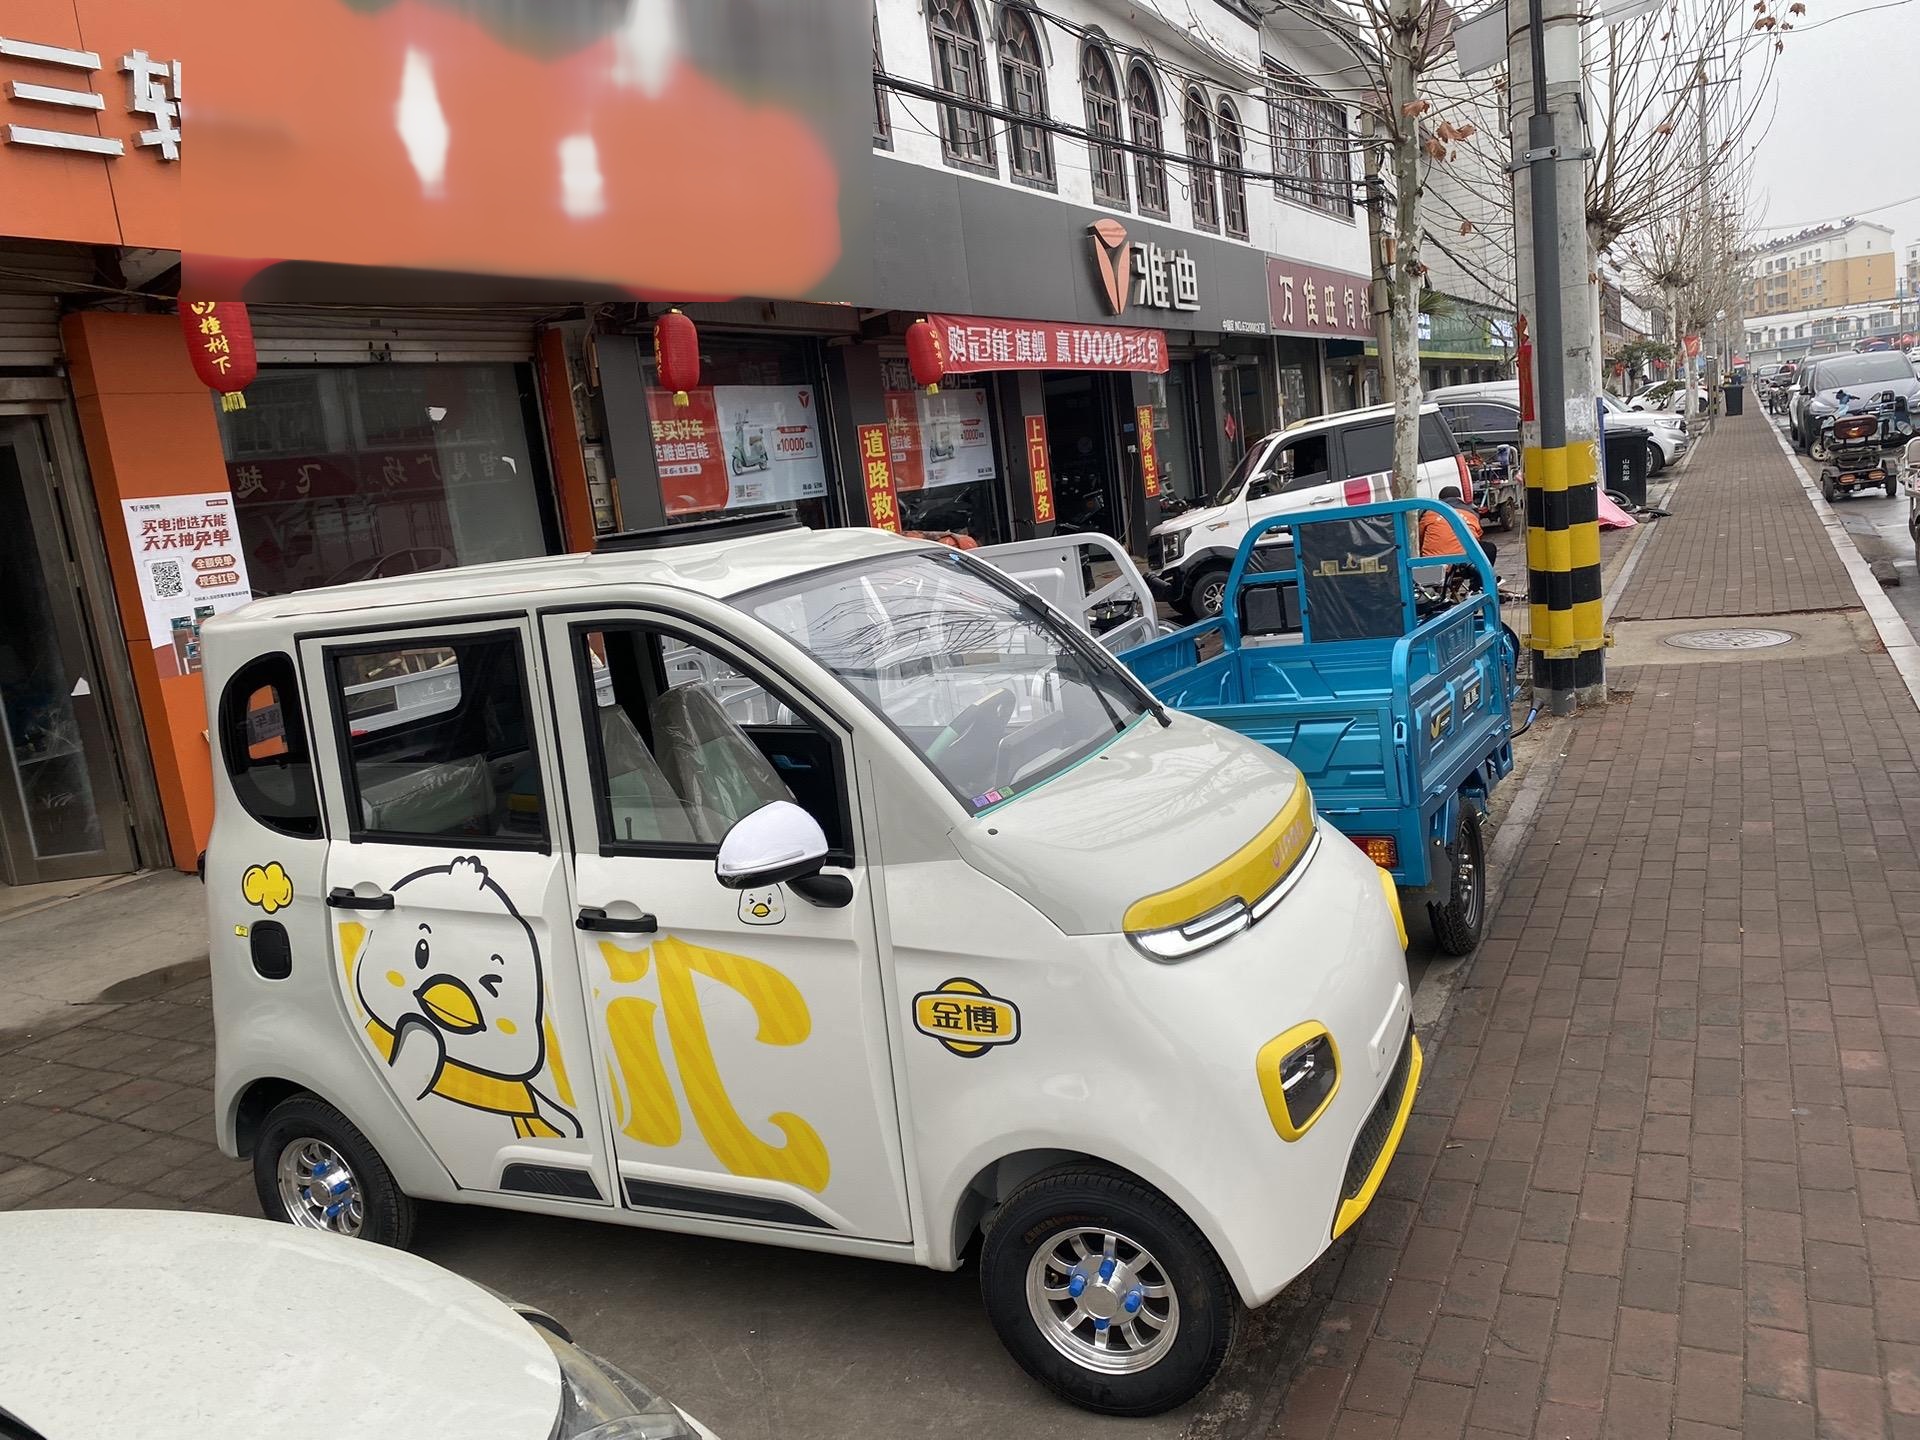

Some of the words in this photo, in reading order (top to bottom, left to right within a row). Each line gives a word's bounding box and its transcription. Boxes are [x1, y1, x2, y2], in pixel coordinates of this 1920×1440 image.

[1133, 241, 1201, 311] 雅迪
[947, 325, 1047, 363] 购冠能旗舰
[1055, 330, 1159, 365] 赢10000元红包
[1139, 409, 1157, 493] 精修电车
[1029, 419, 1051, 519] 上门服务
[141, 513, 228, 536] 买电池选天能
[143, 529, 232, 551] 天天抽免单
[195, 555, 234, 569] 全额免单
[198, 573, 238, 587] 现金红包
[931, 1001, 999, 1034] 金博
